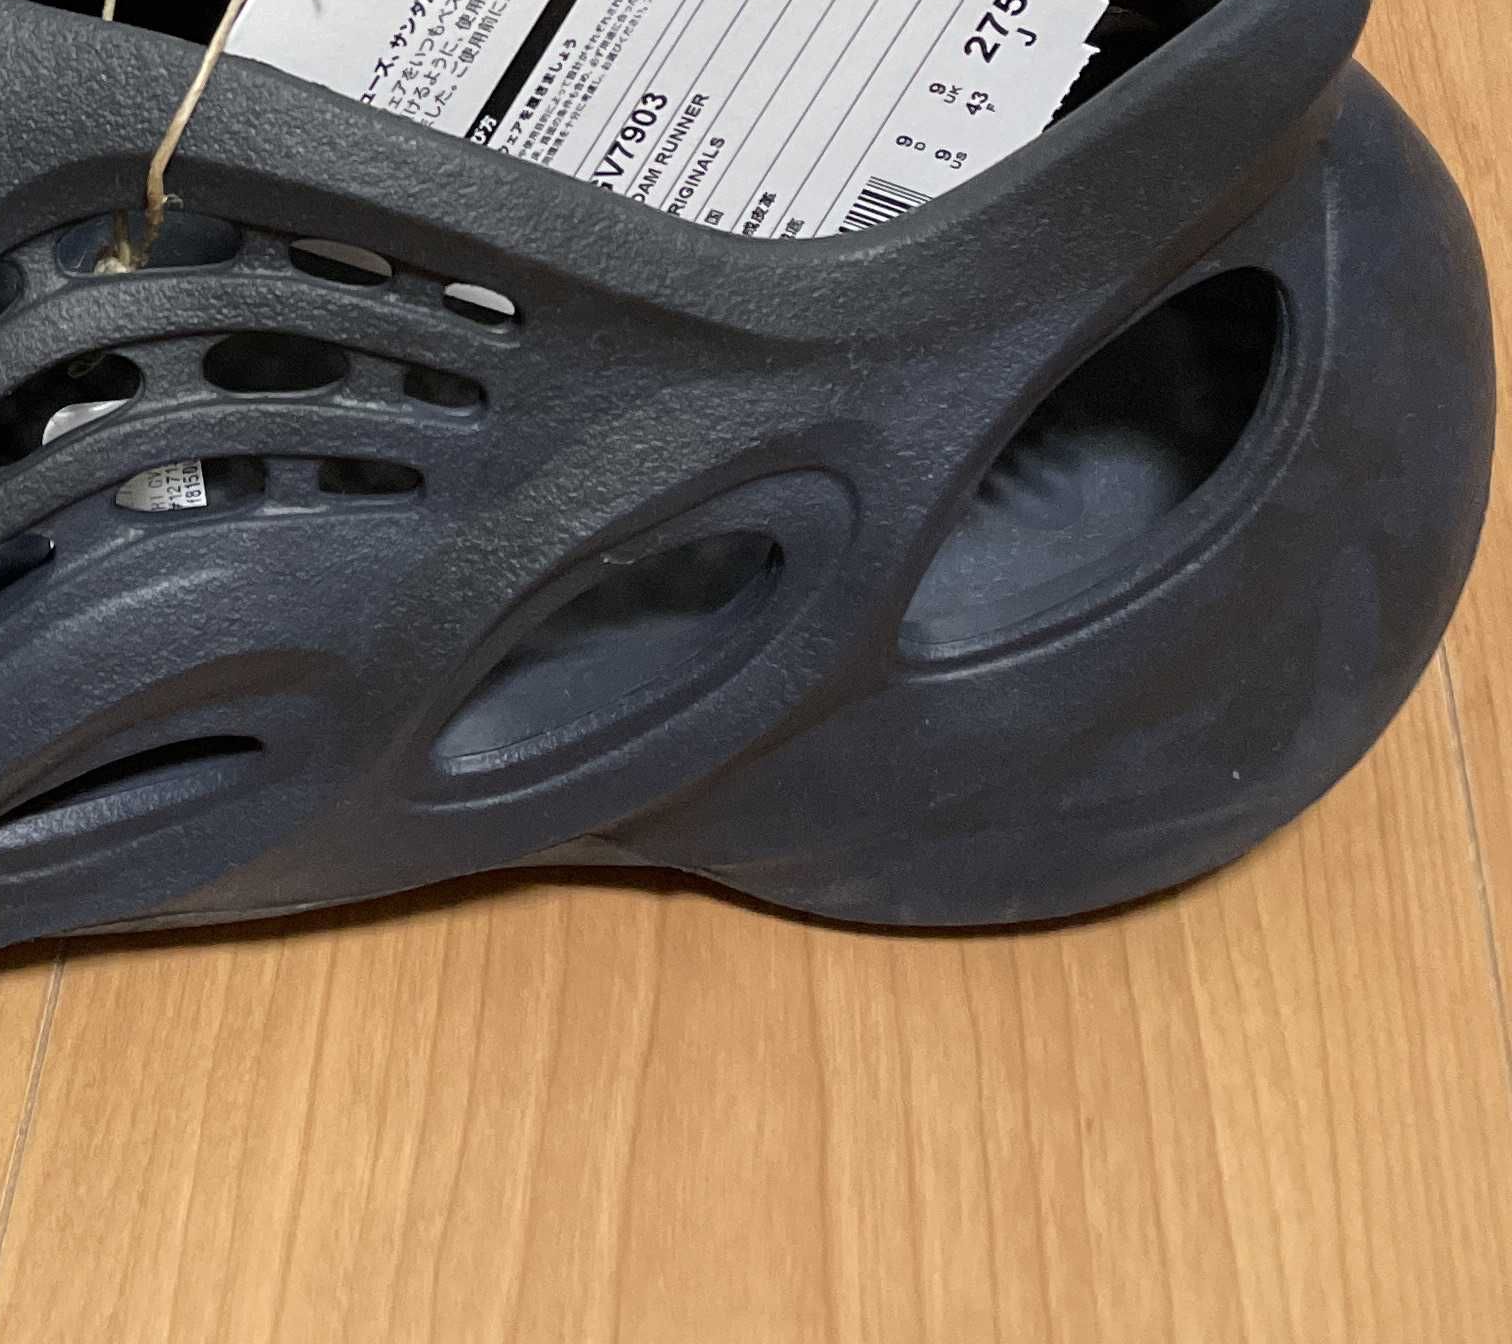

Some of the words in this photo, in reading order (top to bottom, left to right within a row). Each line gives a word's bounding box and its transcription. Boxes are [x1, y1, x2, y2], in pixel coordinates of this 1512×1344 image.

[895, 135, 913, 148] 9
[928, 82, 947, 95] 9
[913, 141, 927, 152] D
[943, 84, 963, 104] UK
[1016, 27, 1038, 47] J
[654, 93, 710, 166] RUNNER
[934, 148, 952, 162] 9
[965, 91, 989, 116] 43
[949, 151, 968, 170] US
[985, 102, 996, 113] F
